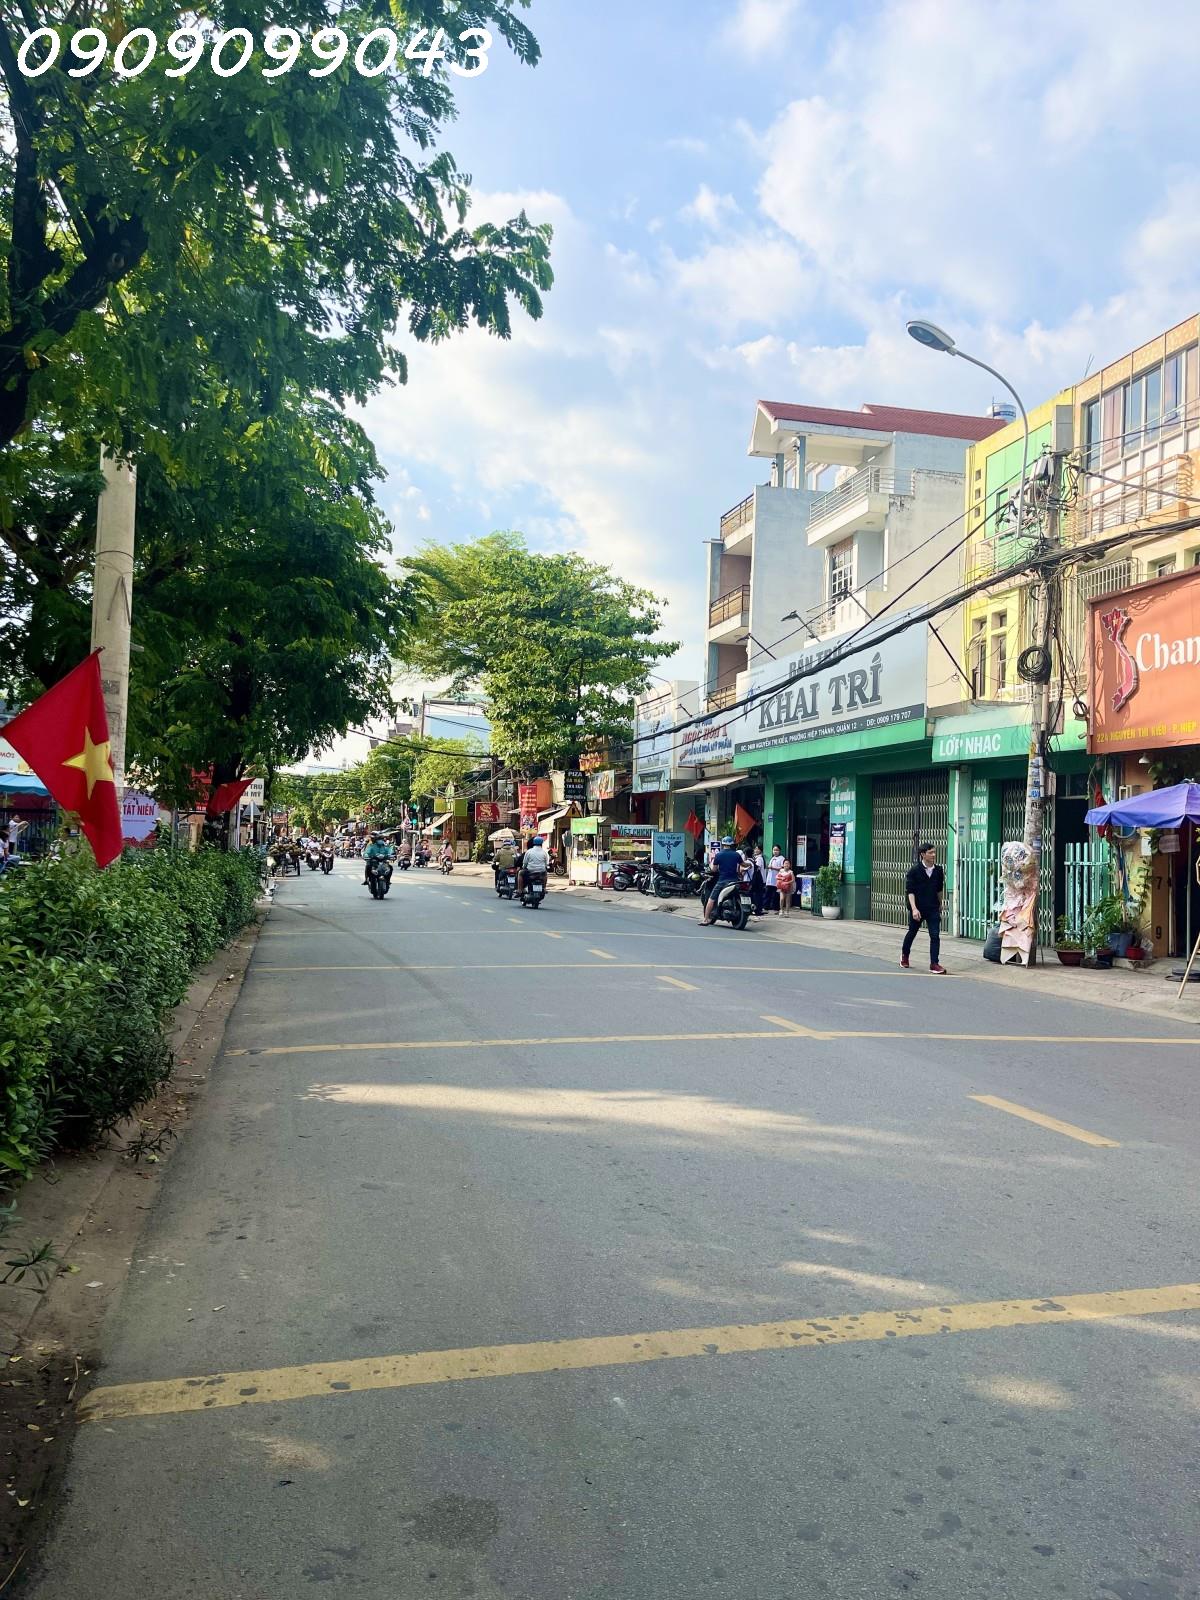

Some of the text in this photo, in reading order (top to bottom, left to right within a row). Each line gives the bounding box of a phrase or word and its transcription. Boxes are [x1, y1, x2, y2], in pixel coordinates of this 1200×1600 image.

[759, 652, 882, 732] KHAI TRÍ
[836, 722, 851, 734] QUẬN
[876, 716, 889, 725] 0909
[940, 733, 1001, 756] LỚP NHẠC
[973, 779, 987, 793] PIANO
[123, 802, 135, 815] TẤT
[972, 796, 987, 809] ORGAN
[971, 812, 987, 826] GUITAR
